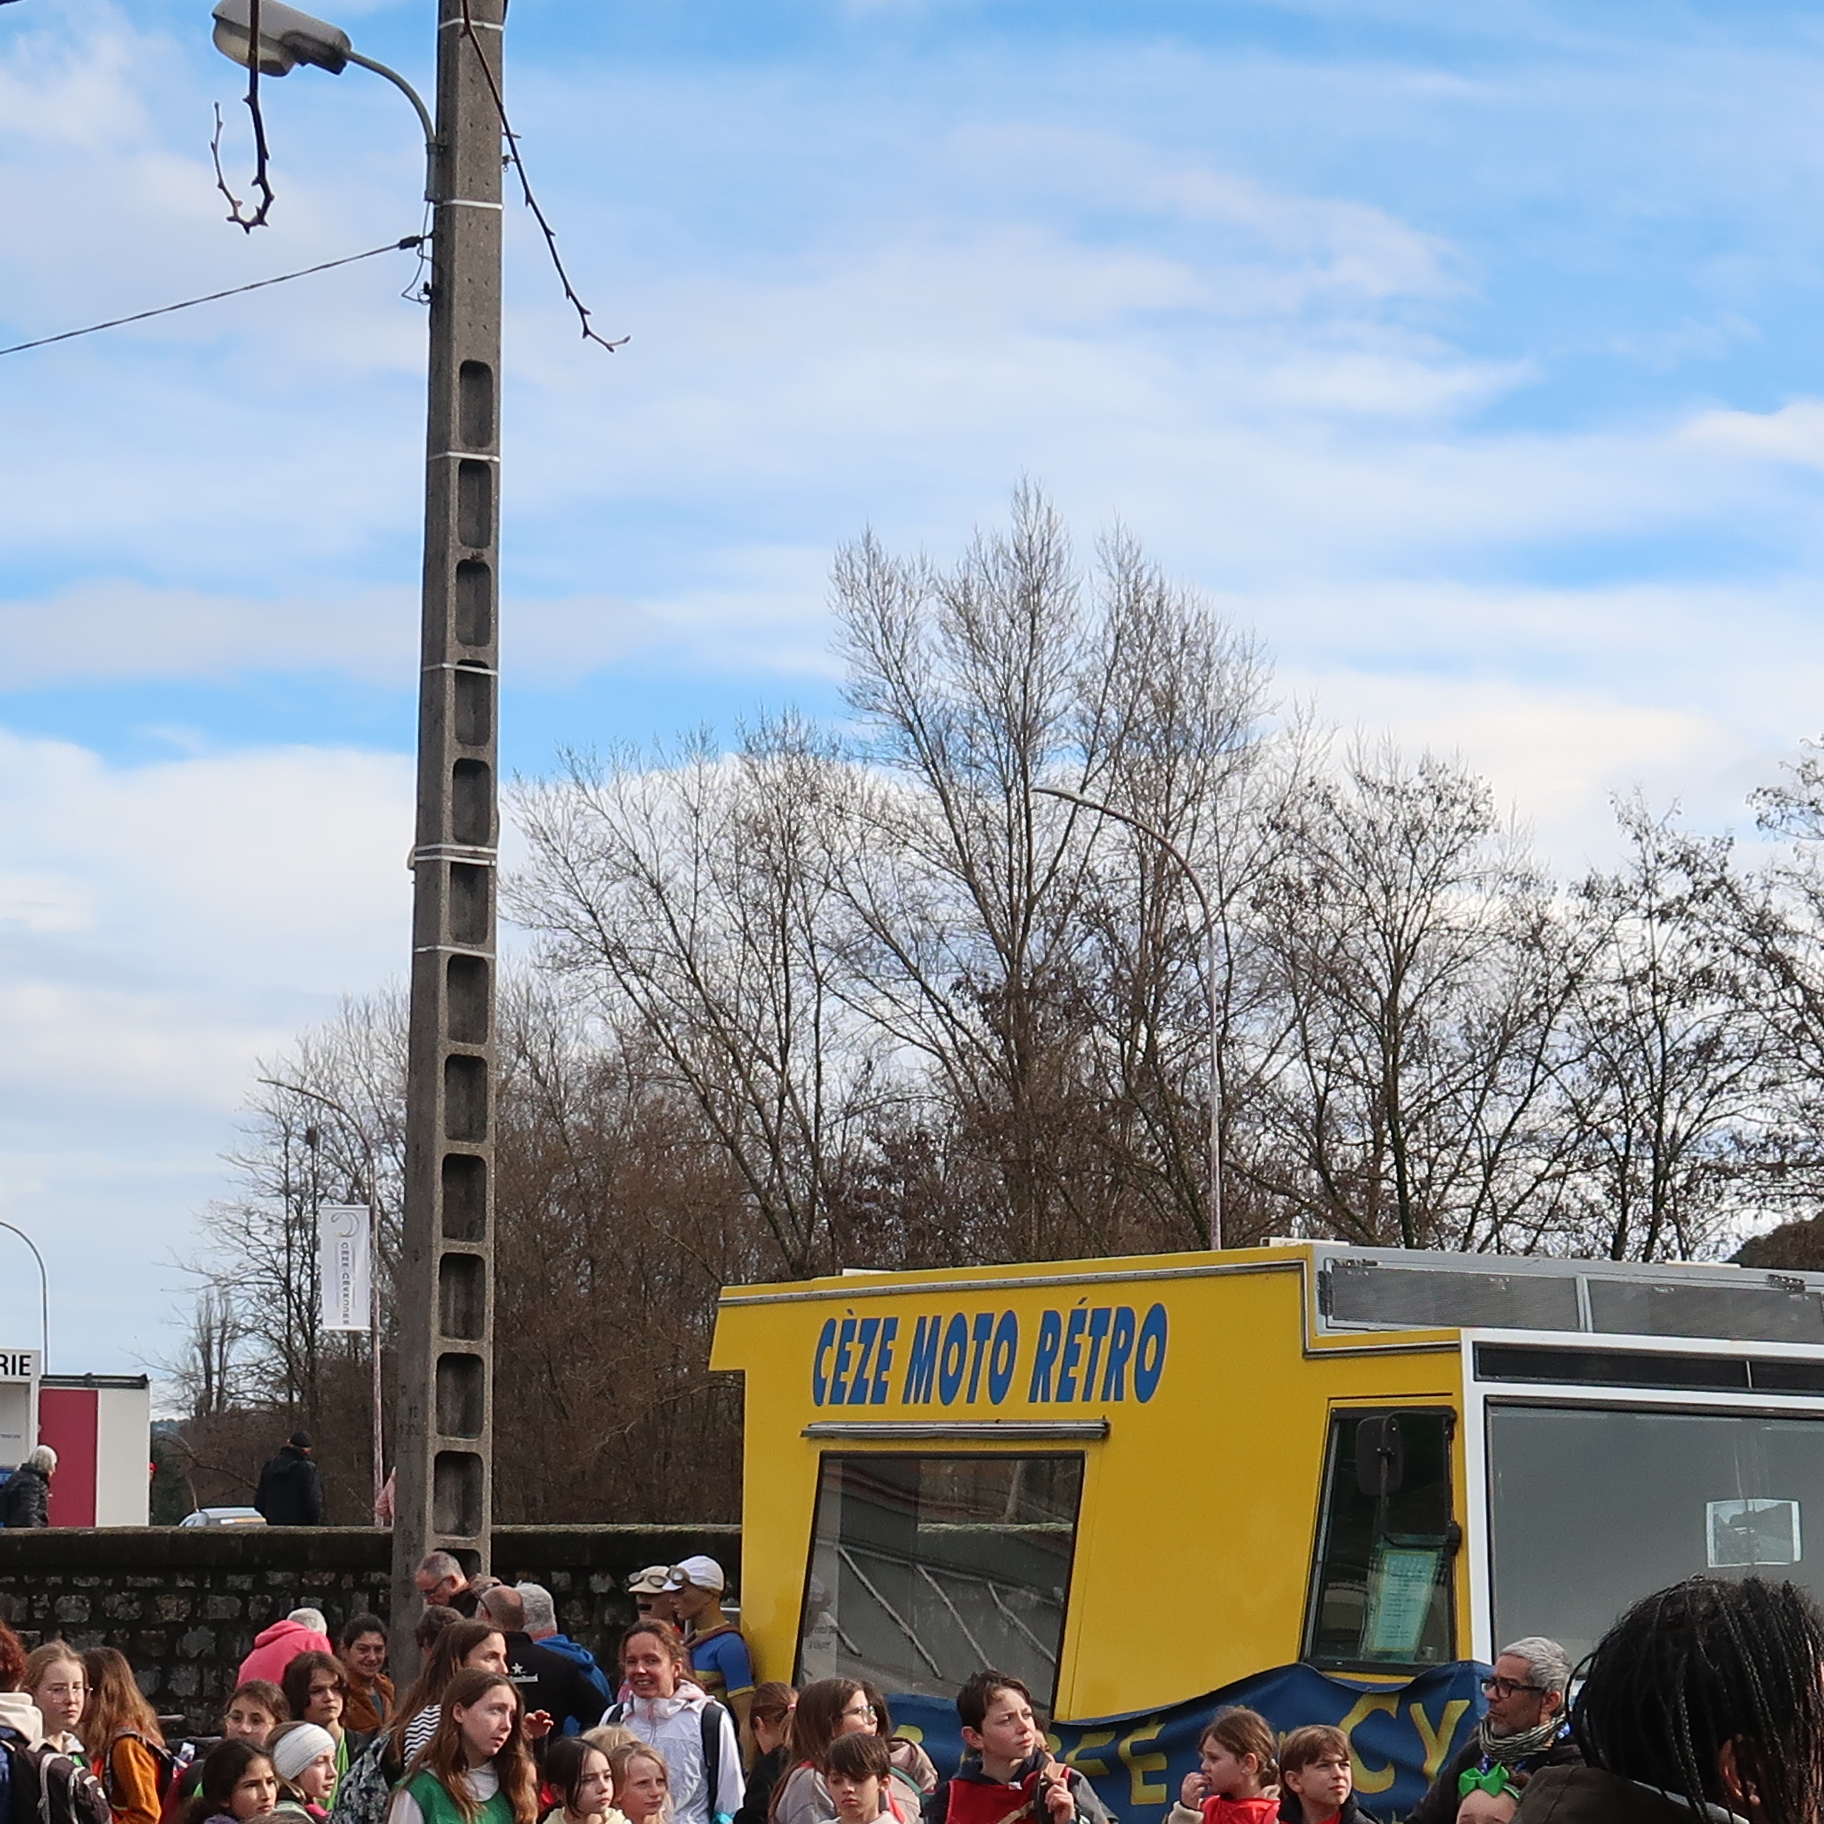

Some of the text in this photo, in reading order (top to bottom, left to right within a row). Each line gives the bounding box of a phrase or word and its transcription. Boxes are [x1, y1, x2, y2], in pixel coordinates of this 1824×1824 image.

[813, 1296, 1168, 1407] CÈZE MOTO RÉTRO
